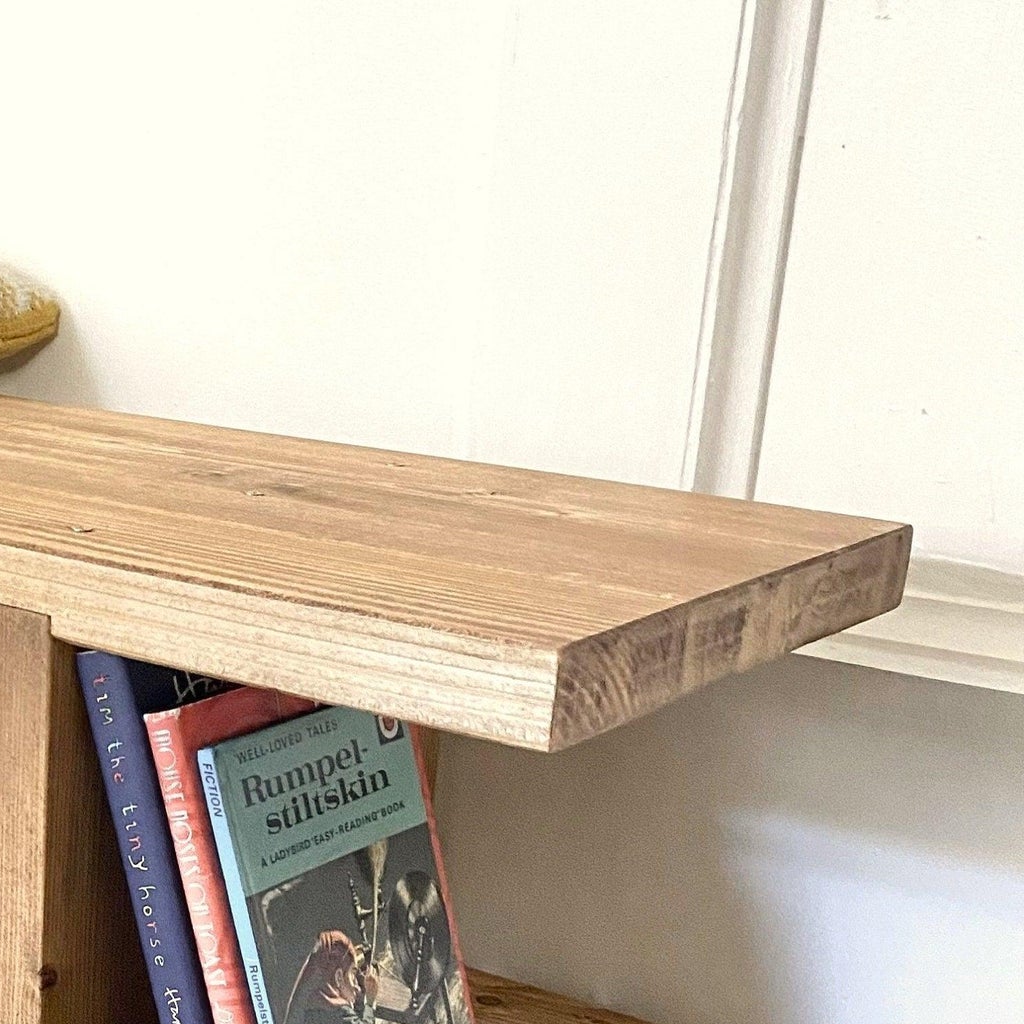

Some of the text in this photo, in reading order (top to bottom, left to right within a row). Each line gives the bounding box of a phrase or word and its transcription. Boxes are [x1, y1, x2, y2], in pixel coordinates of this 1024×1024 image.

[306, 718, 339, 739] TALES
[202, 762, 223, 818] FICTION
[239, 738, 369, 809] Rumpel-
[265, 768, 392, 836] stiltskin
[107, 738, 125, 784] the
[122, 801, 149, 871] tiny
[138, 885, 165, 967] horse
[260, 856, 269, 869] A
[269, 838, 312, 865] LADYBIRD
[380, 799, 406, 818] BOOK
